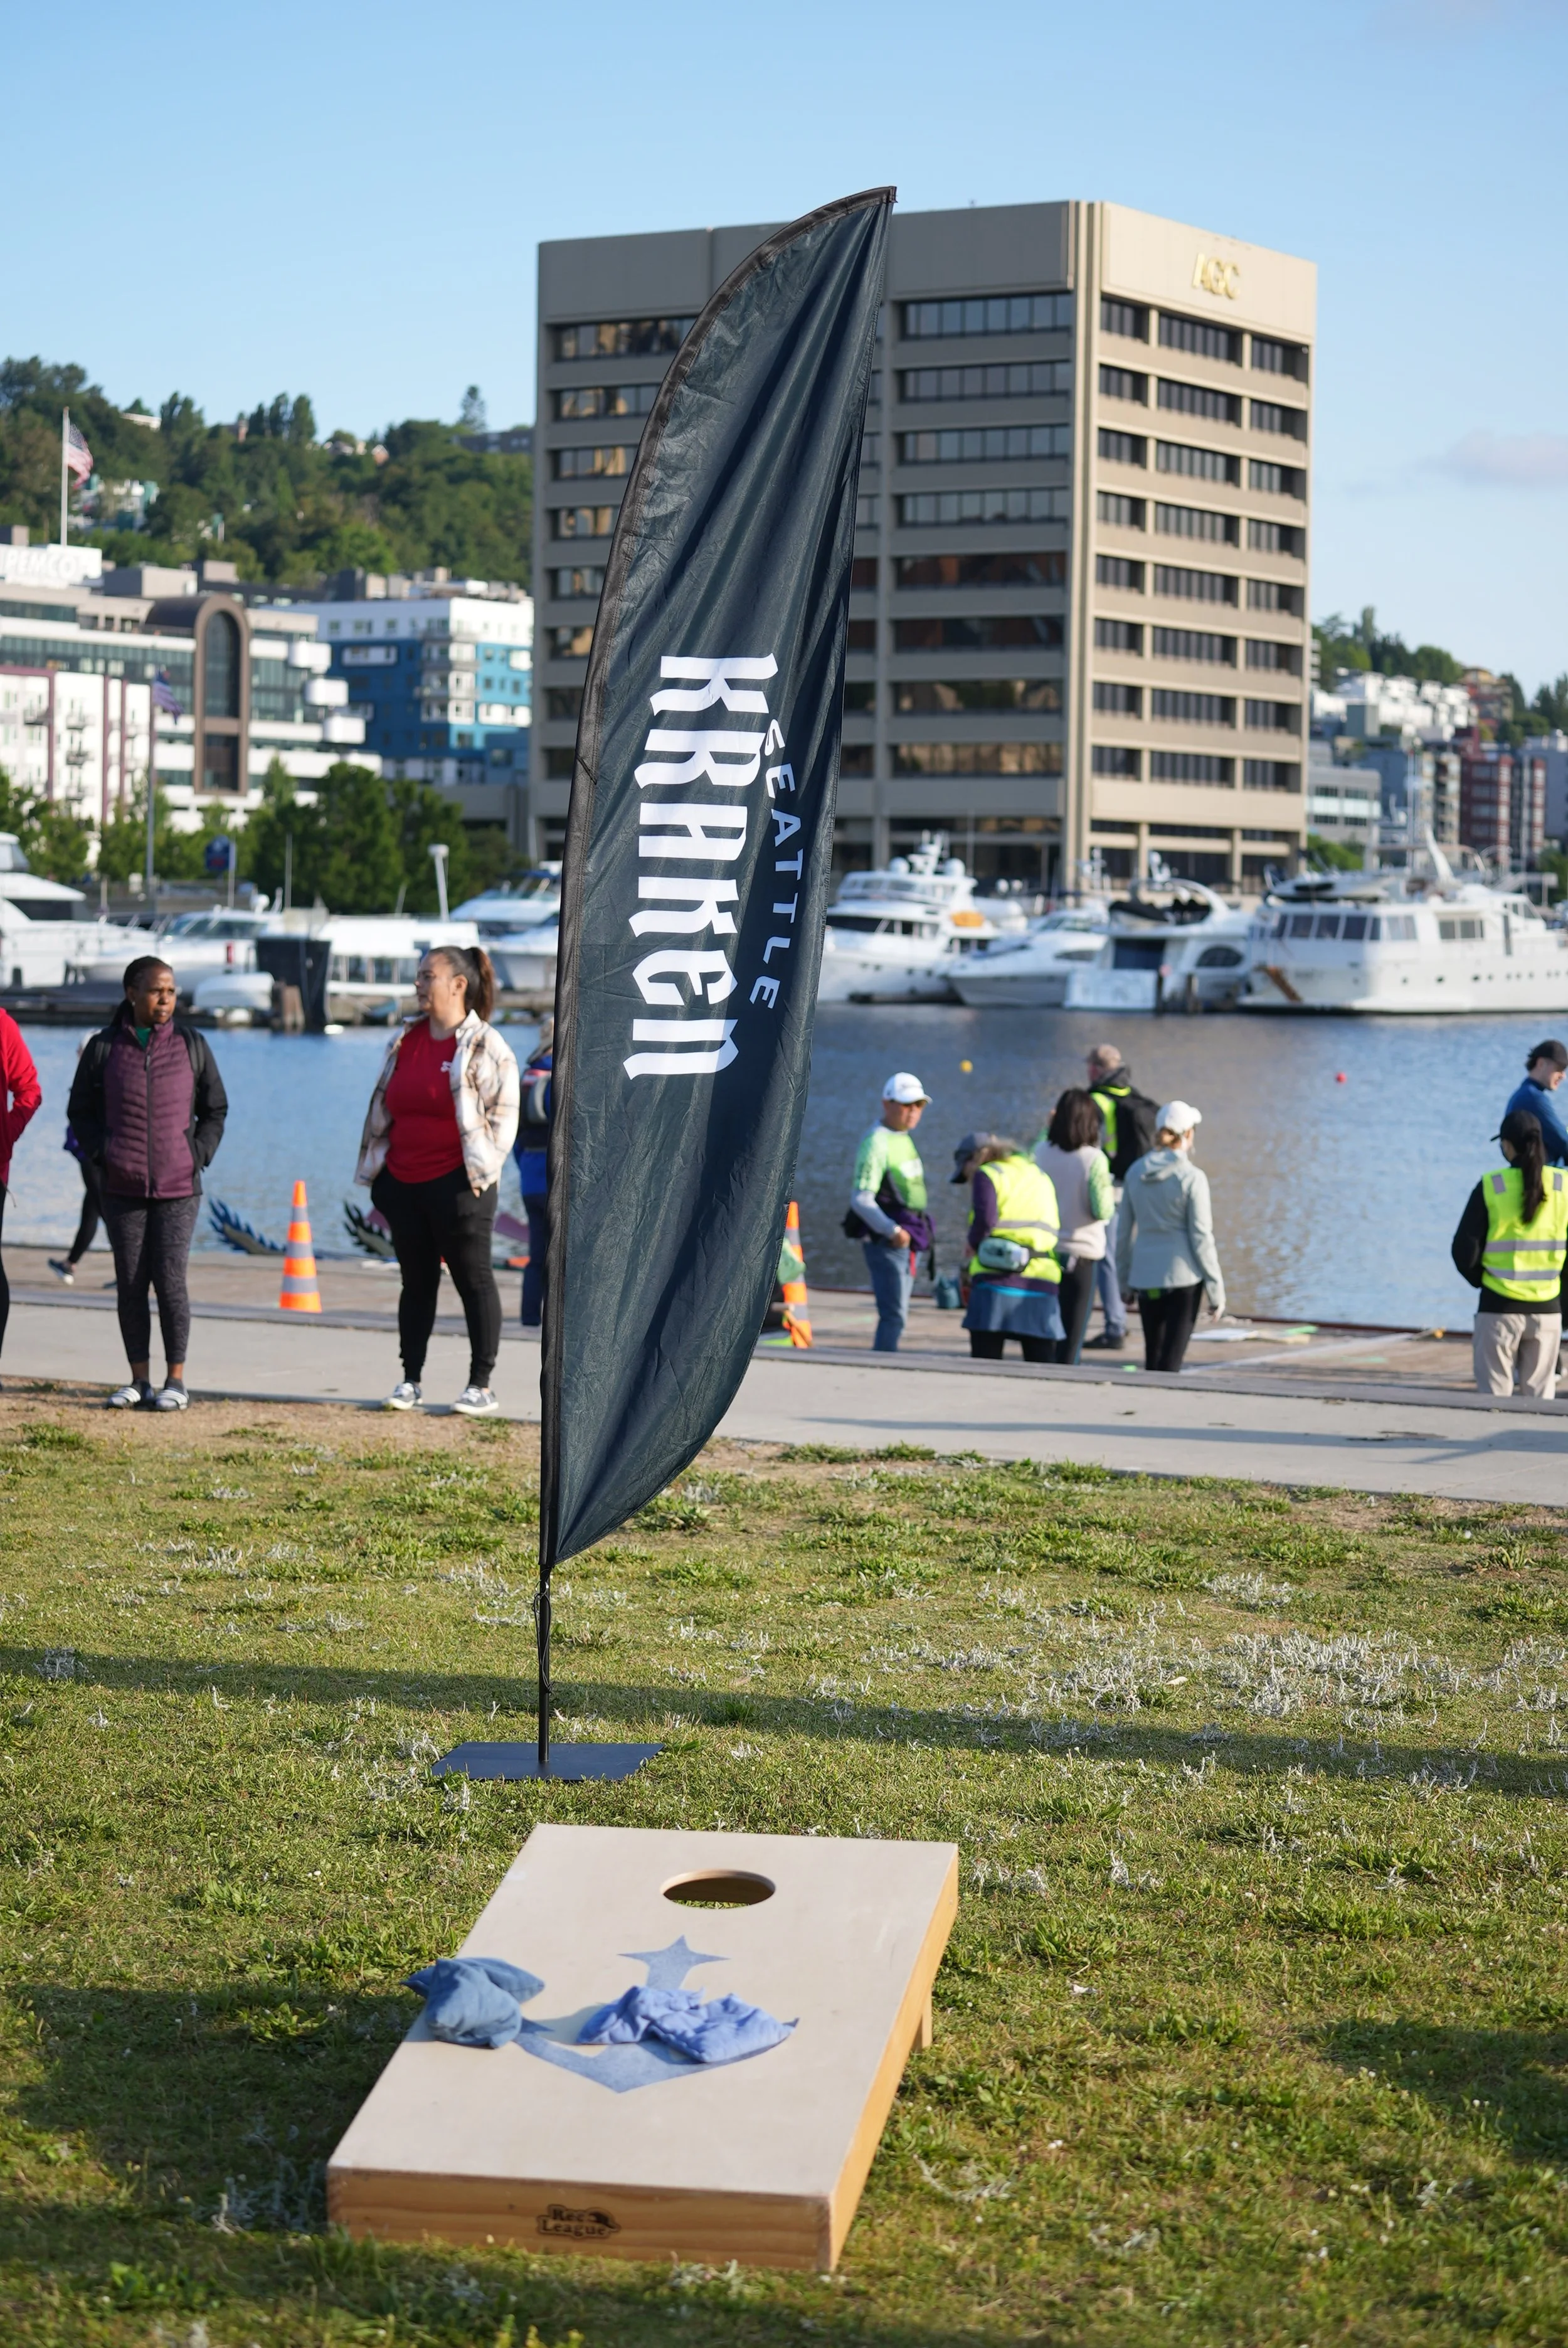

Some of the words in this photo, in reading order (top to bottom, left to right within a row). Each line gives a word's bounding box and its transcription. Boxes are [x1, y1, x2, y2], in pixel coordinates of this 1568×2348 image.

[1192, 252, 1240, 300] AGC
[6, 549, 77, 579] PEMCO
[749, 718, 803, 1009] SEATTLE
[541, 2218, 606, 2237] League
[553, 2208, 585, 2222] Rec
